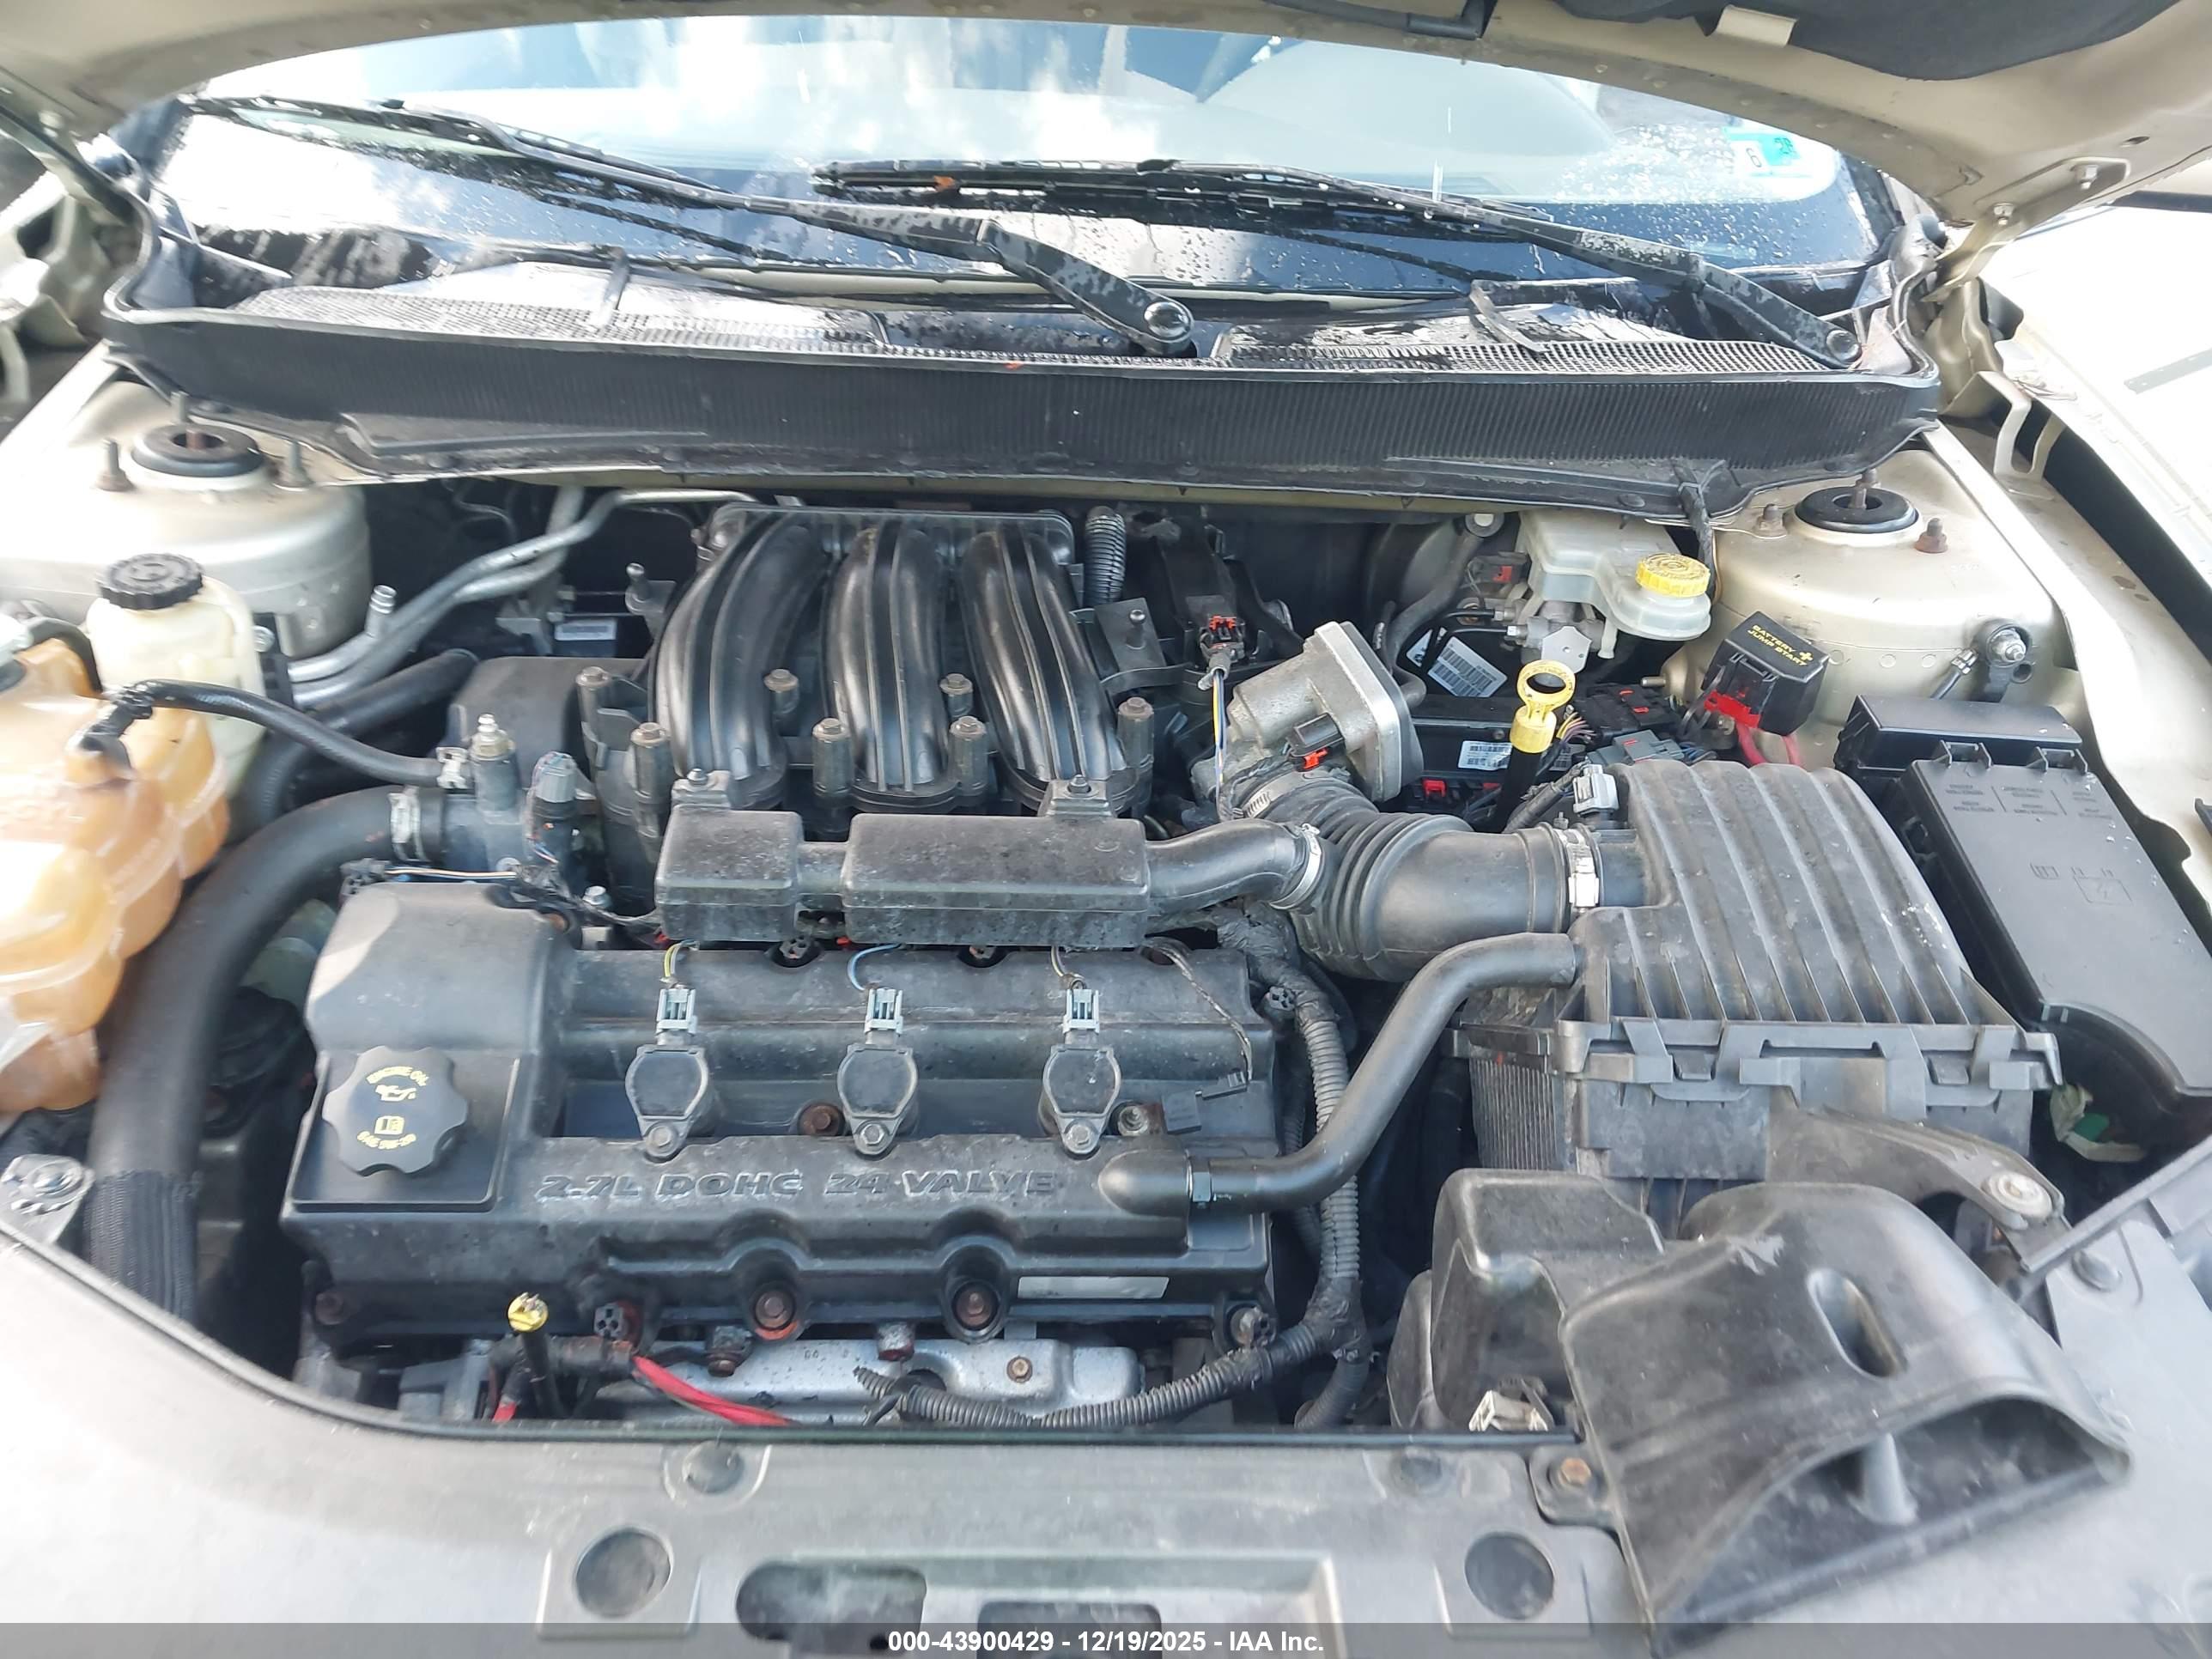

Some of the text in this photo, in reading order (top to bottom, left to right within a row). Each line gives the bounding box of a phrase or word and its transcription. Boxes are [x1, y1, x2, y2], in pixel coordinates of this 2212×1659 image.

[1747, 629, 1808, 665] JUMP START
[1753, 625, 1796, 652] BATTERY
[534, 1170, 1056, 1203] 2.7L DOHC 24 VALVE
